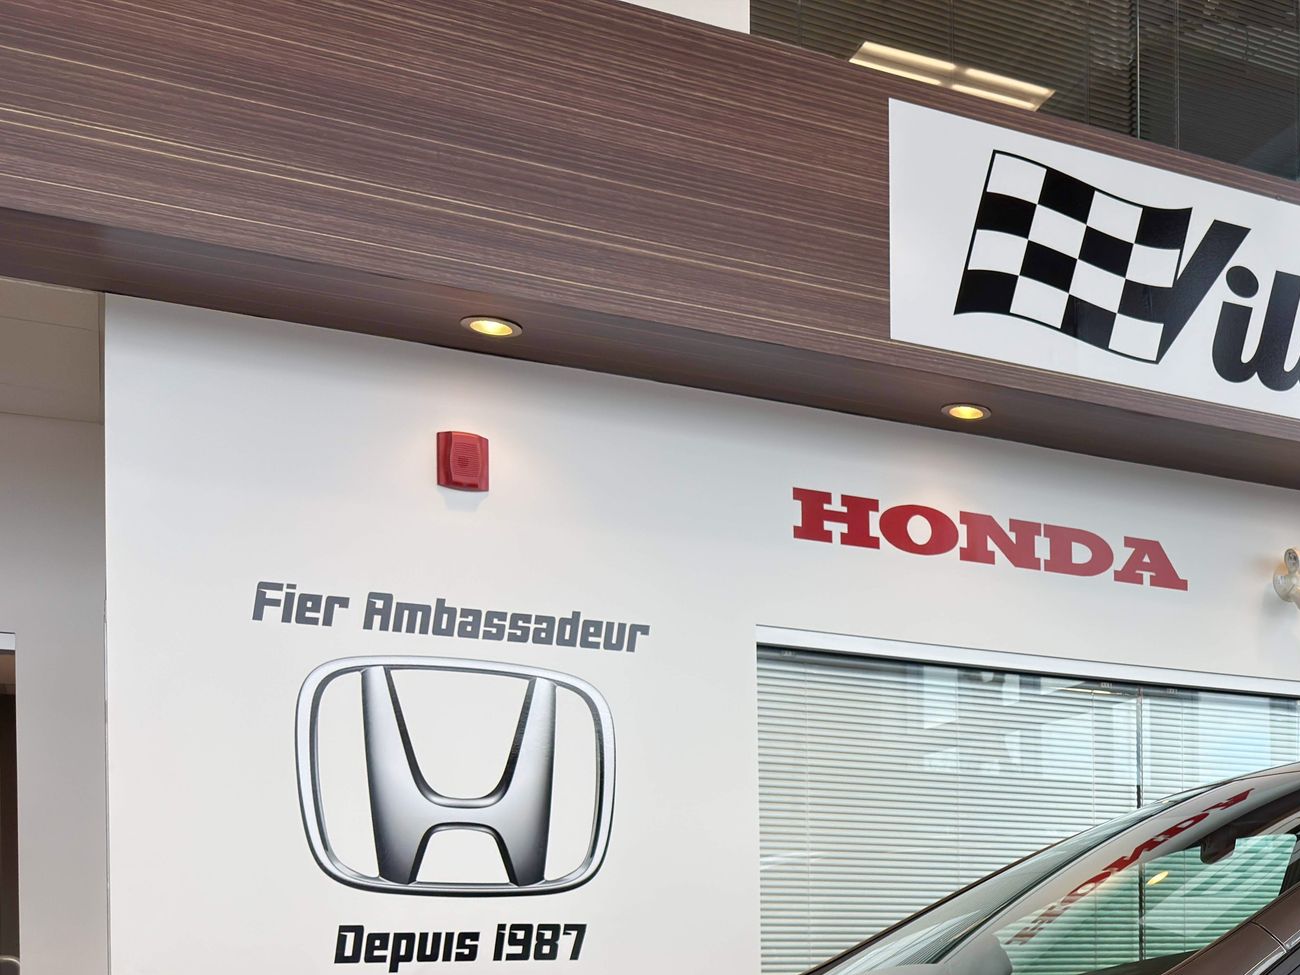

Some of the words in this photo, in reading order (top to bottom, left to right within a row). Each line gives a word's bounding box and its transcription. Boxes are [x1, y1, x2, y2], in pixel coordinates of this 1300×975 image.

[792, 486, 1189, 592] HONDA
[252, 581, 350, 627] Fier
[363, 591, 650, 652] Ambassadeur
[334, 924, 480, 973] Depuis
[493, 923, 587, 961] 1987
